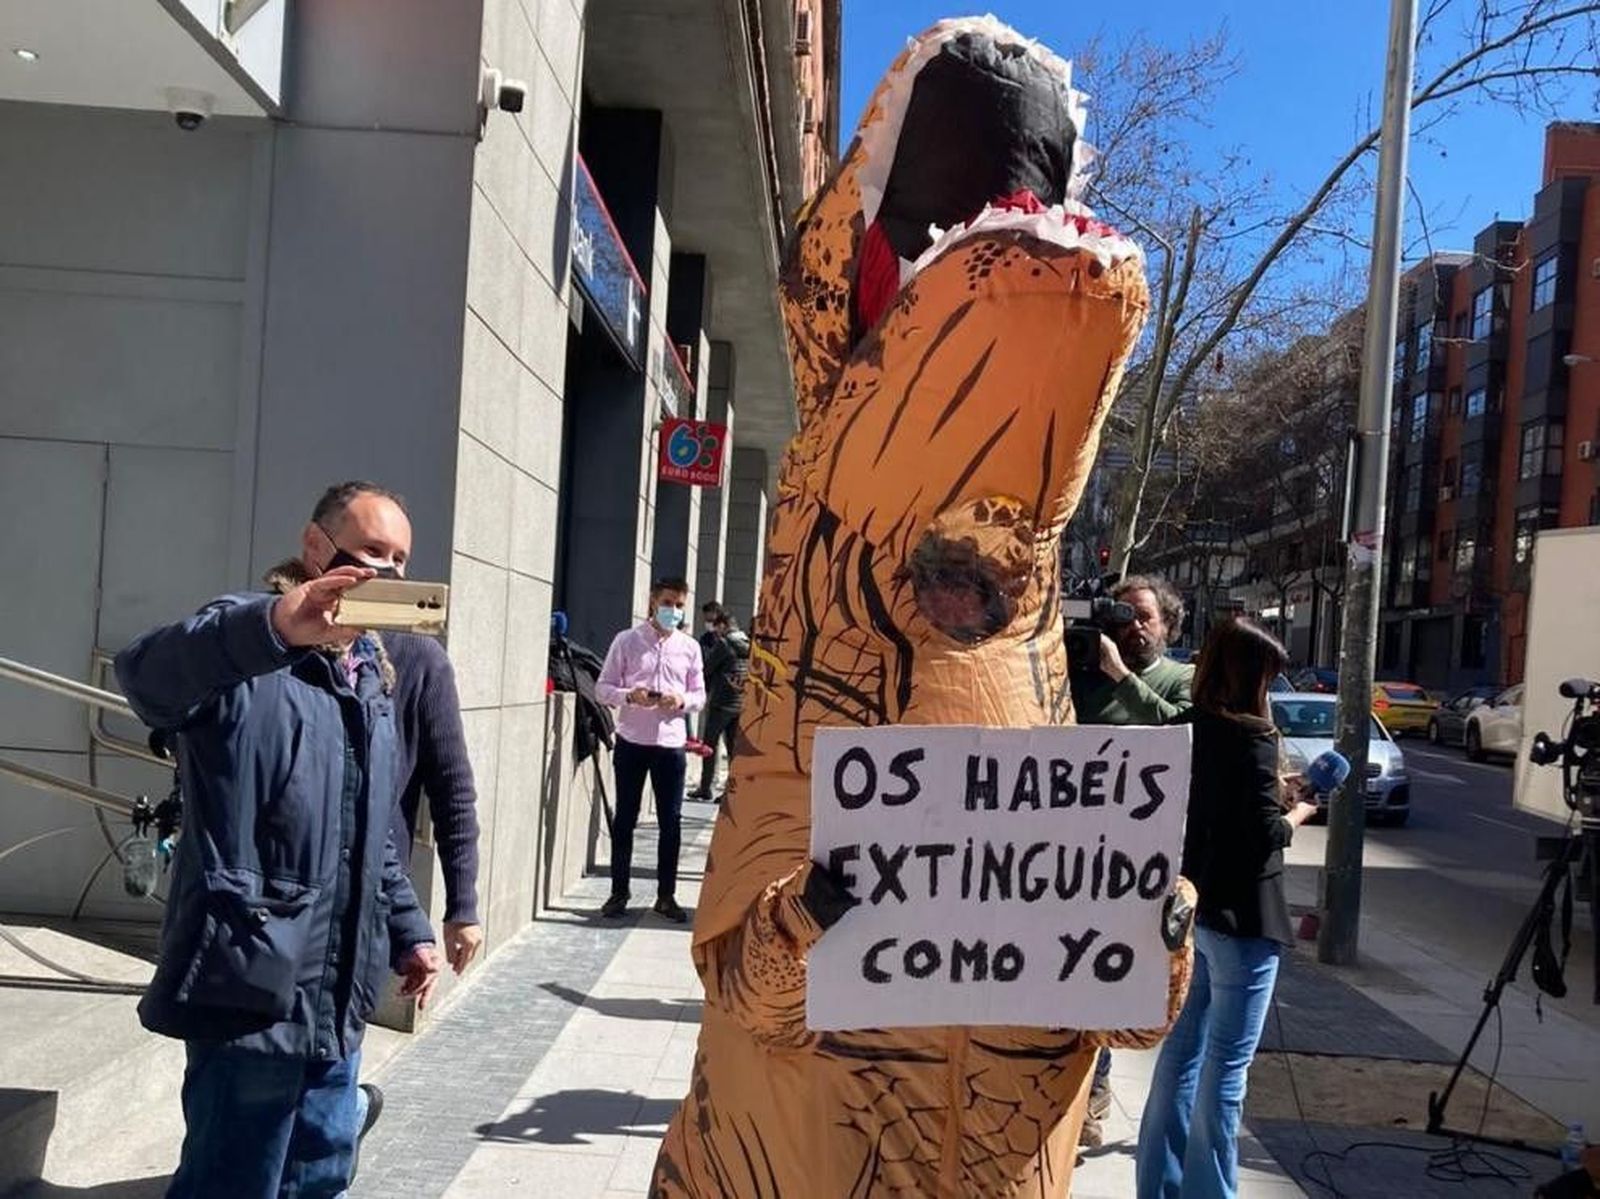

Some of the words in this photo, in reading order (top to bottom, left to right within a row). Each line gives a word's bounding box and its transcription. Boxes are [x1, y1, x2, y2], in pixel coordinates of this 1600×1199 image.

[834, 746, 925, 810] OS
[862, 937, 1025, 983] COMO
[1058, 928, 1135, 983] YO
